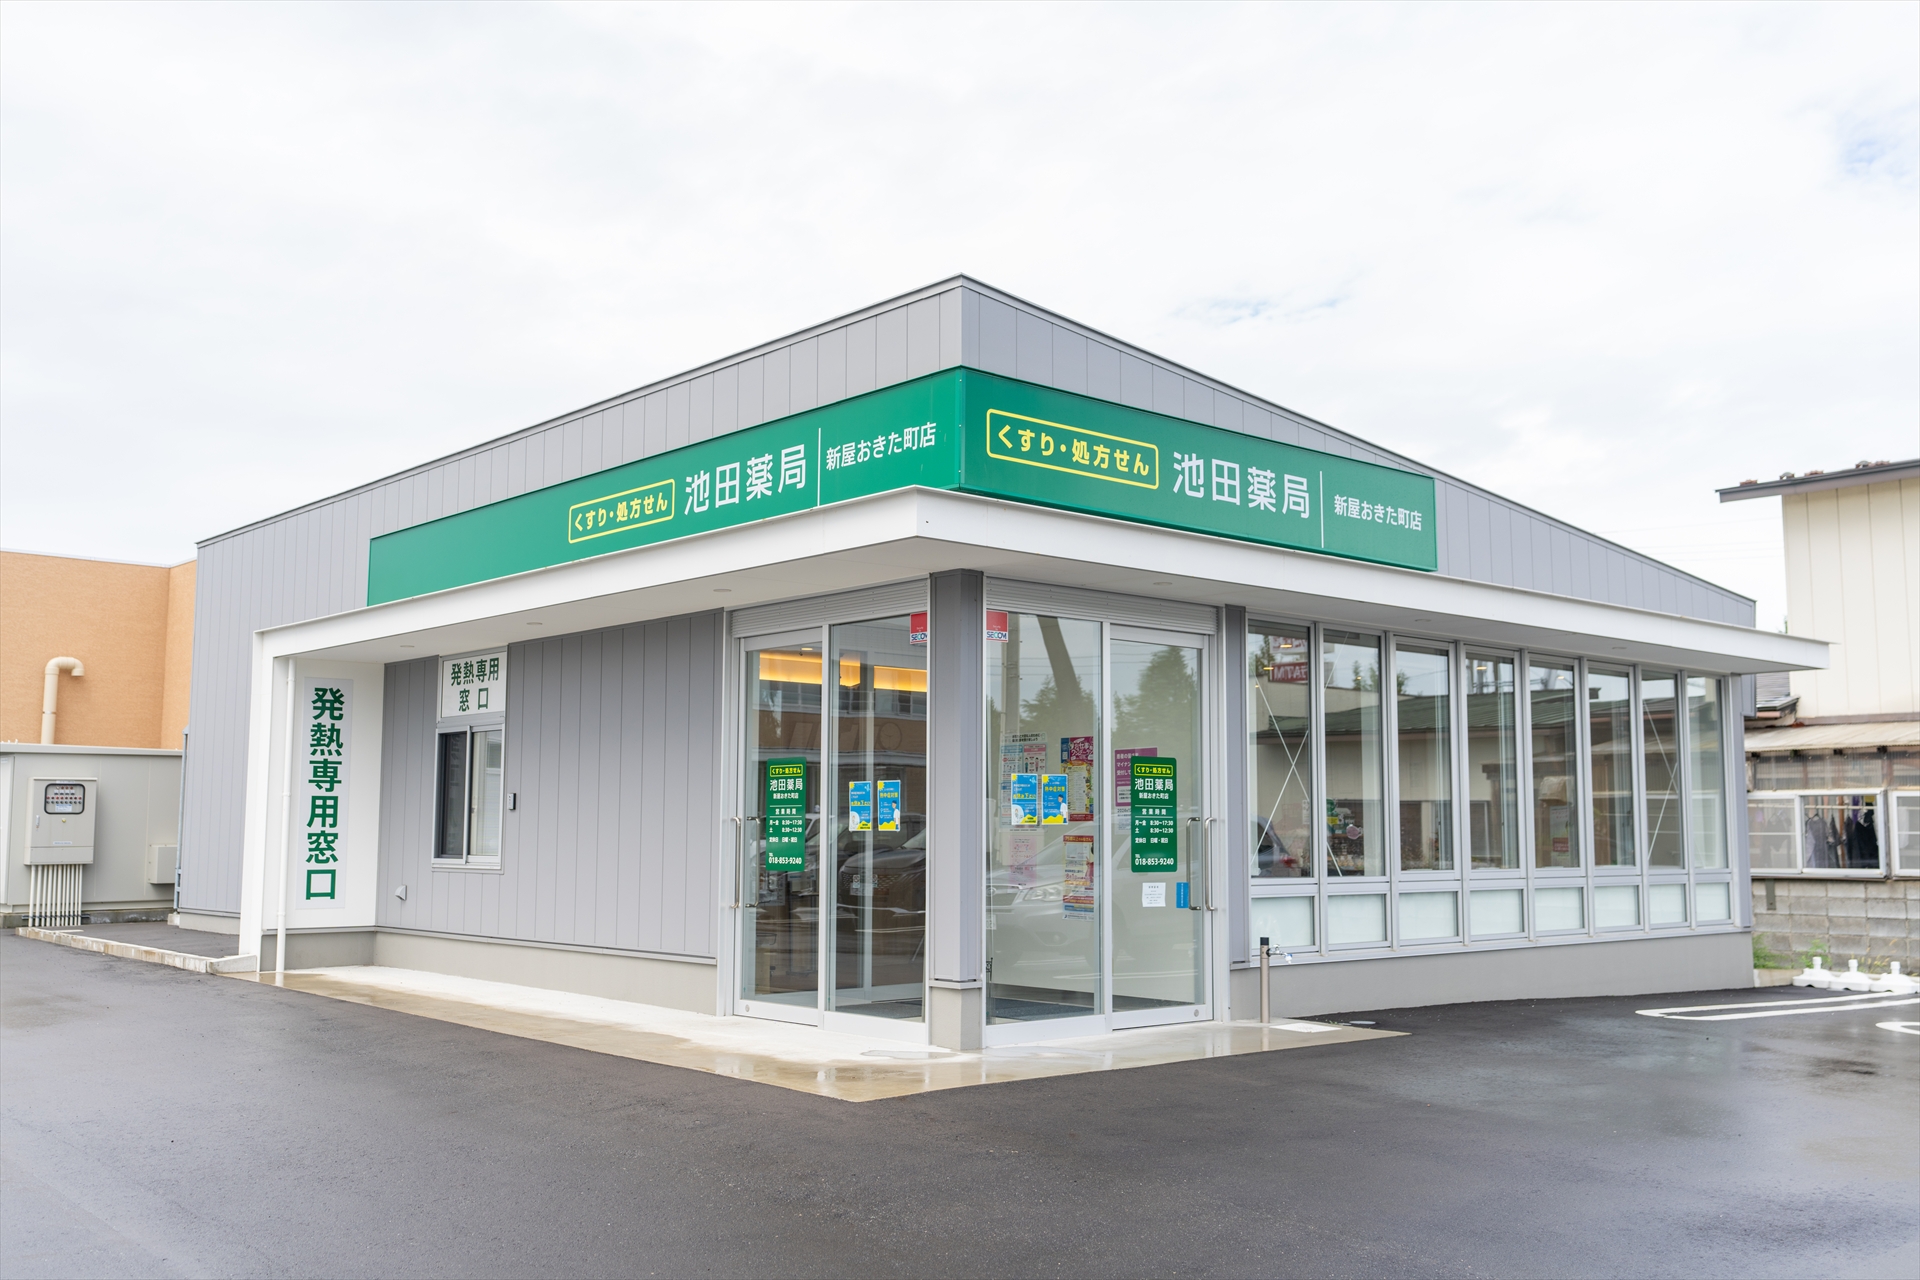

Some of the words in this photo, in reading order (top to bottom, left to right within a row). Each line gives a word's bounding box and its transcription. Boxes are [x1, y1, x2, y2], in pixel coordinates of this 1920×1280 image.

[574, 492, 668, 532] くすり・処方せん
[684, 443, 807, 516] 池田薬局
[826, 421, 937, 471] 新屋おきた町店
[998, 424, 1150, 477] くすり・処方せん
[1172, 451, 1310, 519] 池田薬局
[1333, 494, 1422, 532] 新屋おきた町店
[986, 631, 1007, 640] SECOM
[450, 657, 500, 686] 発熱専用
[458, 687, 489, 712] 窓口
[305, 687, 345, 900] 発熱専用窓口
[770, 778, 803, 791] 池田薬局
[1134, 778, 1173, 791] 池田薬局
[768, 856, 802, 865] 018-853-9240
[1135, 858, 1174, 866] 018-853-9240
